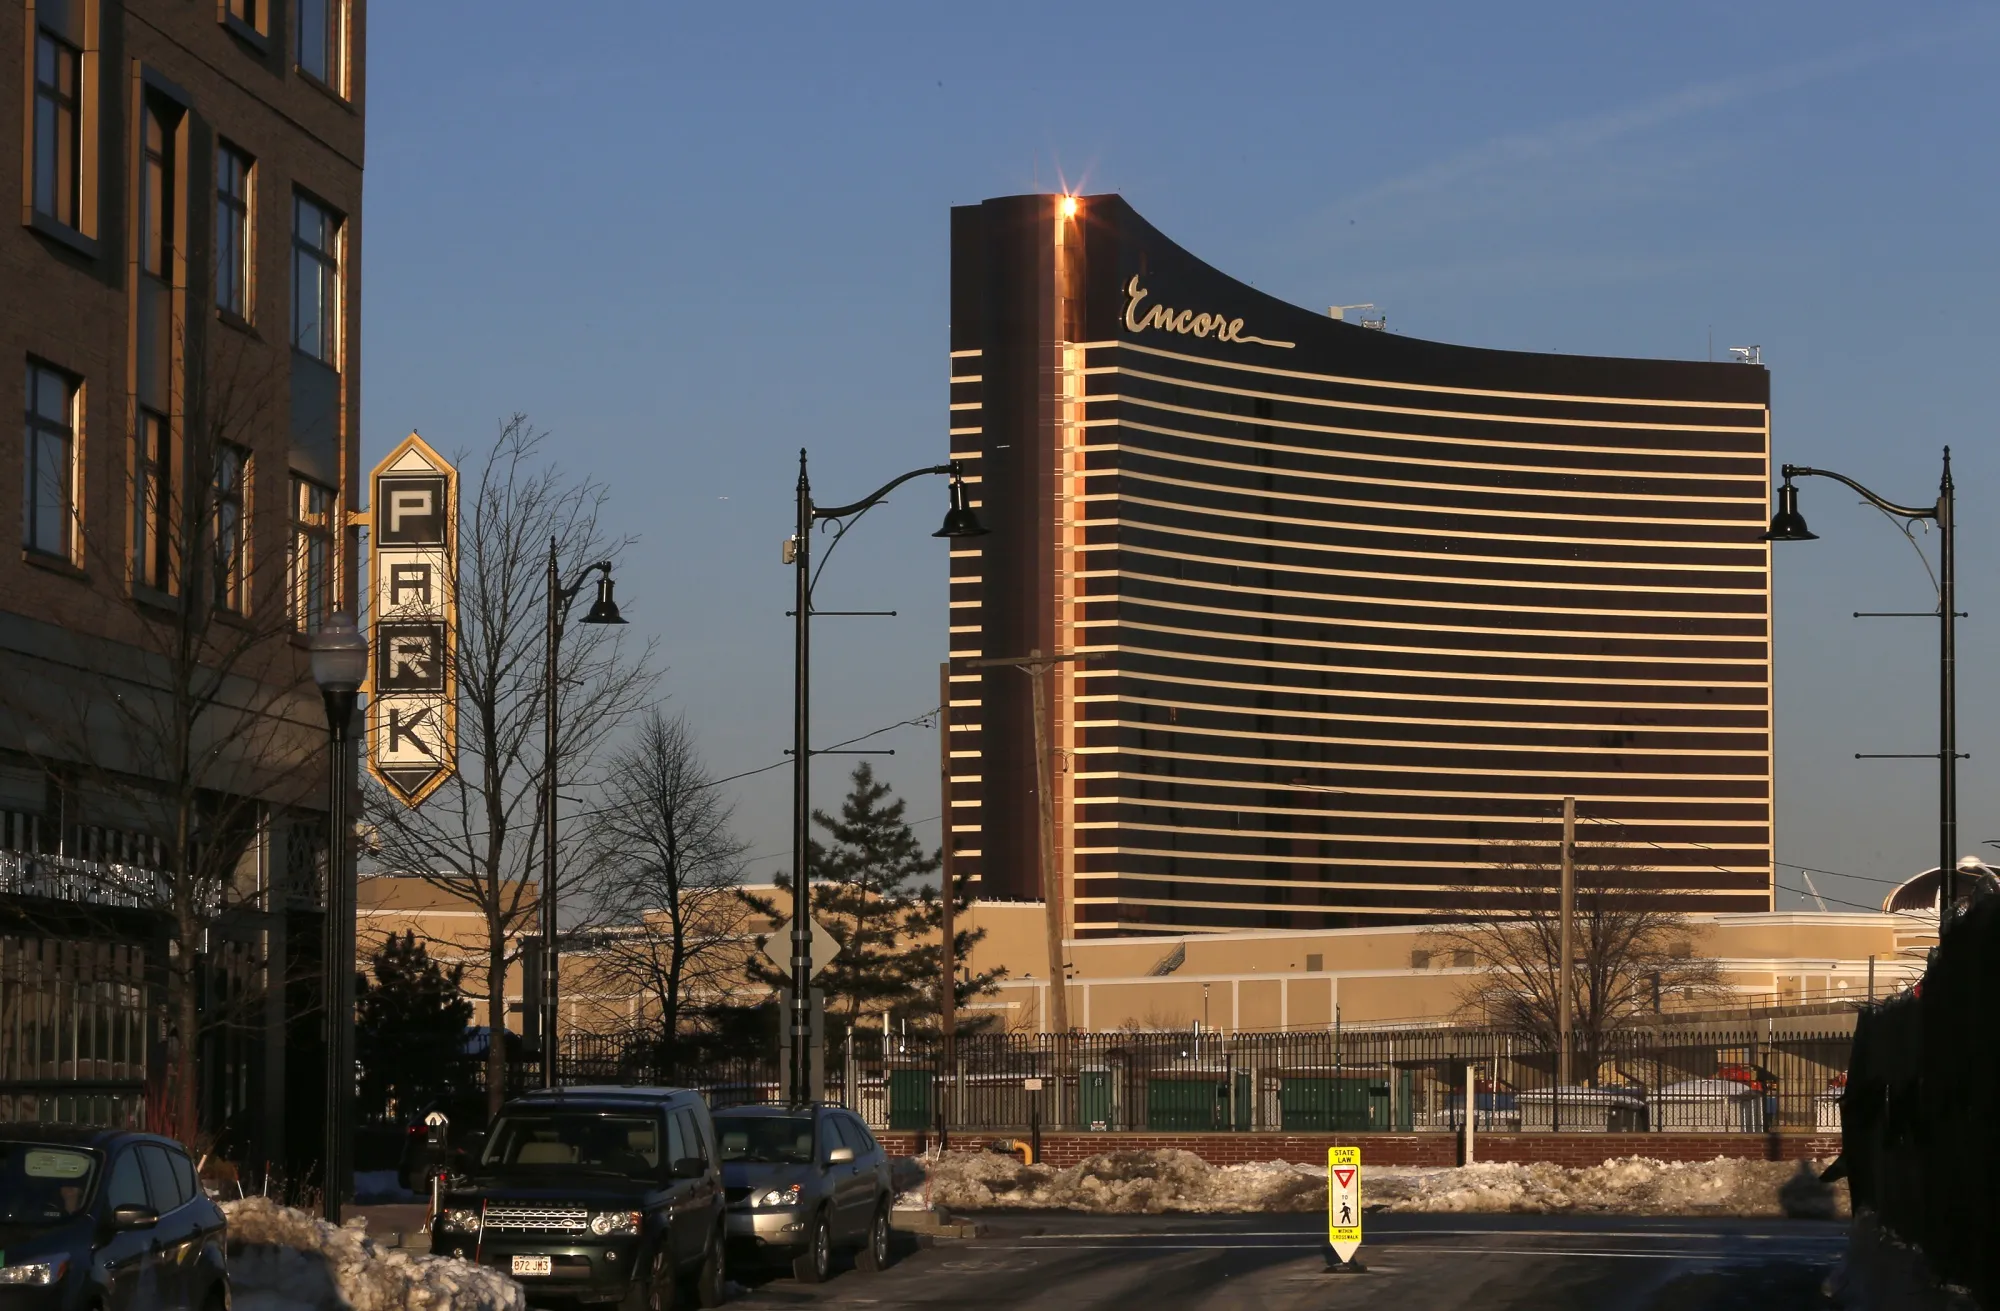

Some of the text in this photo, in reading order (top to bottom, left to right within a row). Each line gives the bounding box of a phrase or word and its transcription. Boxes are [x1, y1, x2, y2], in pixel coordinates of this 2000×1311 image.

[1125, 273, 1297, 349] Encore
[389, 489, 433, 754] PARK
[514, 1260, 530, 1271] 872
